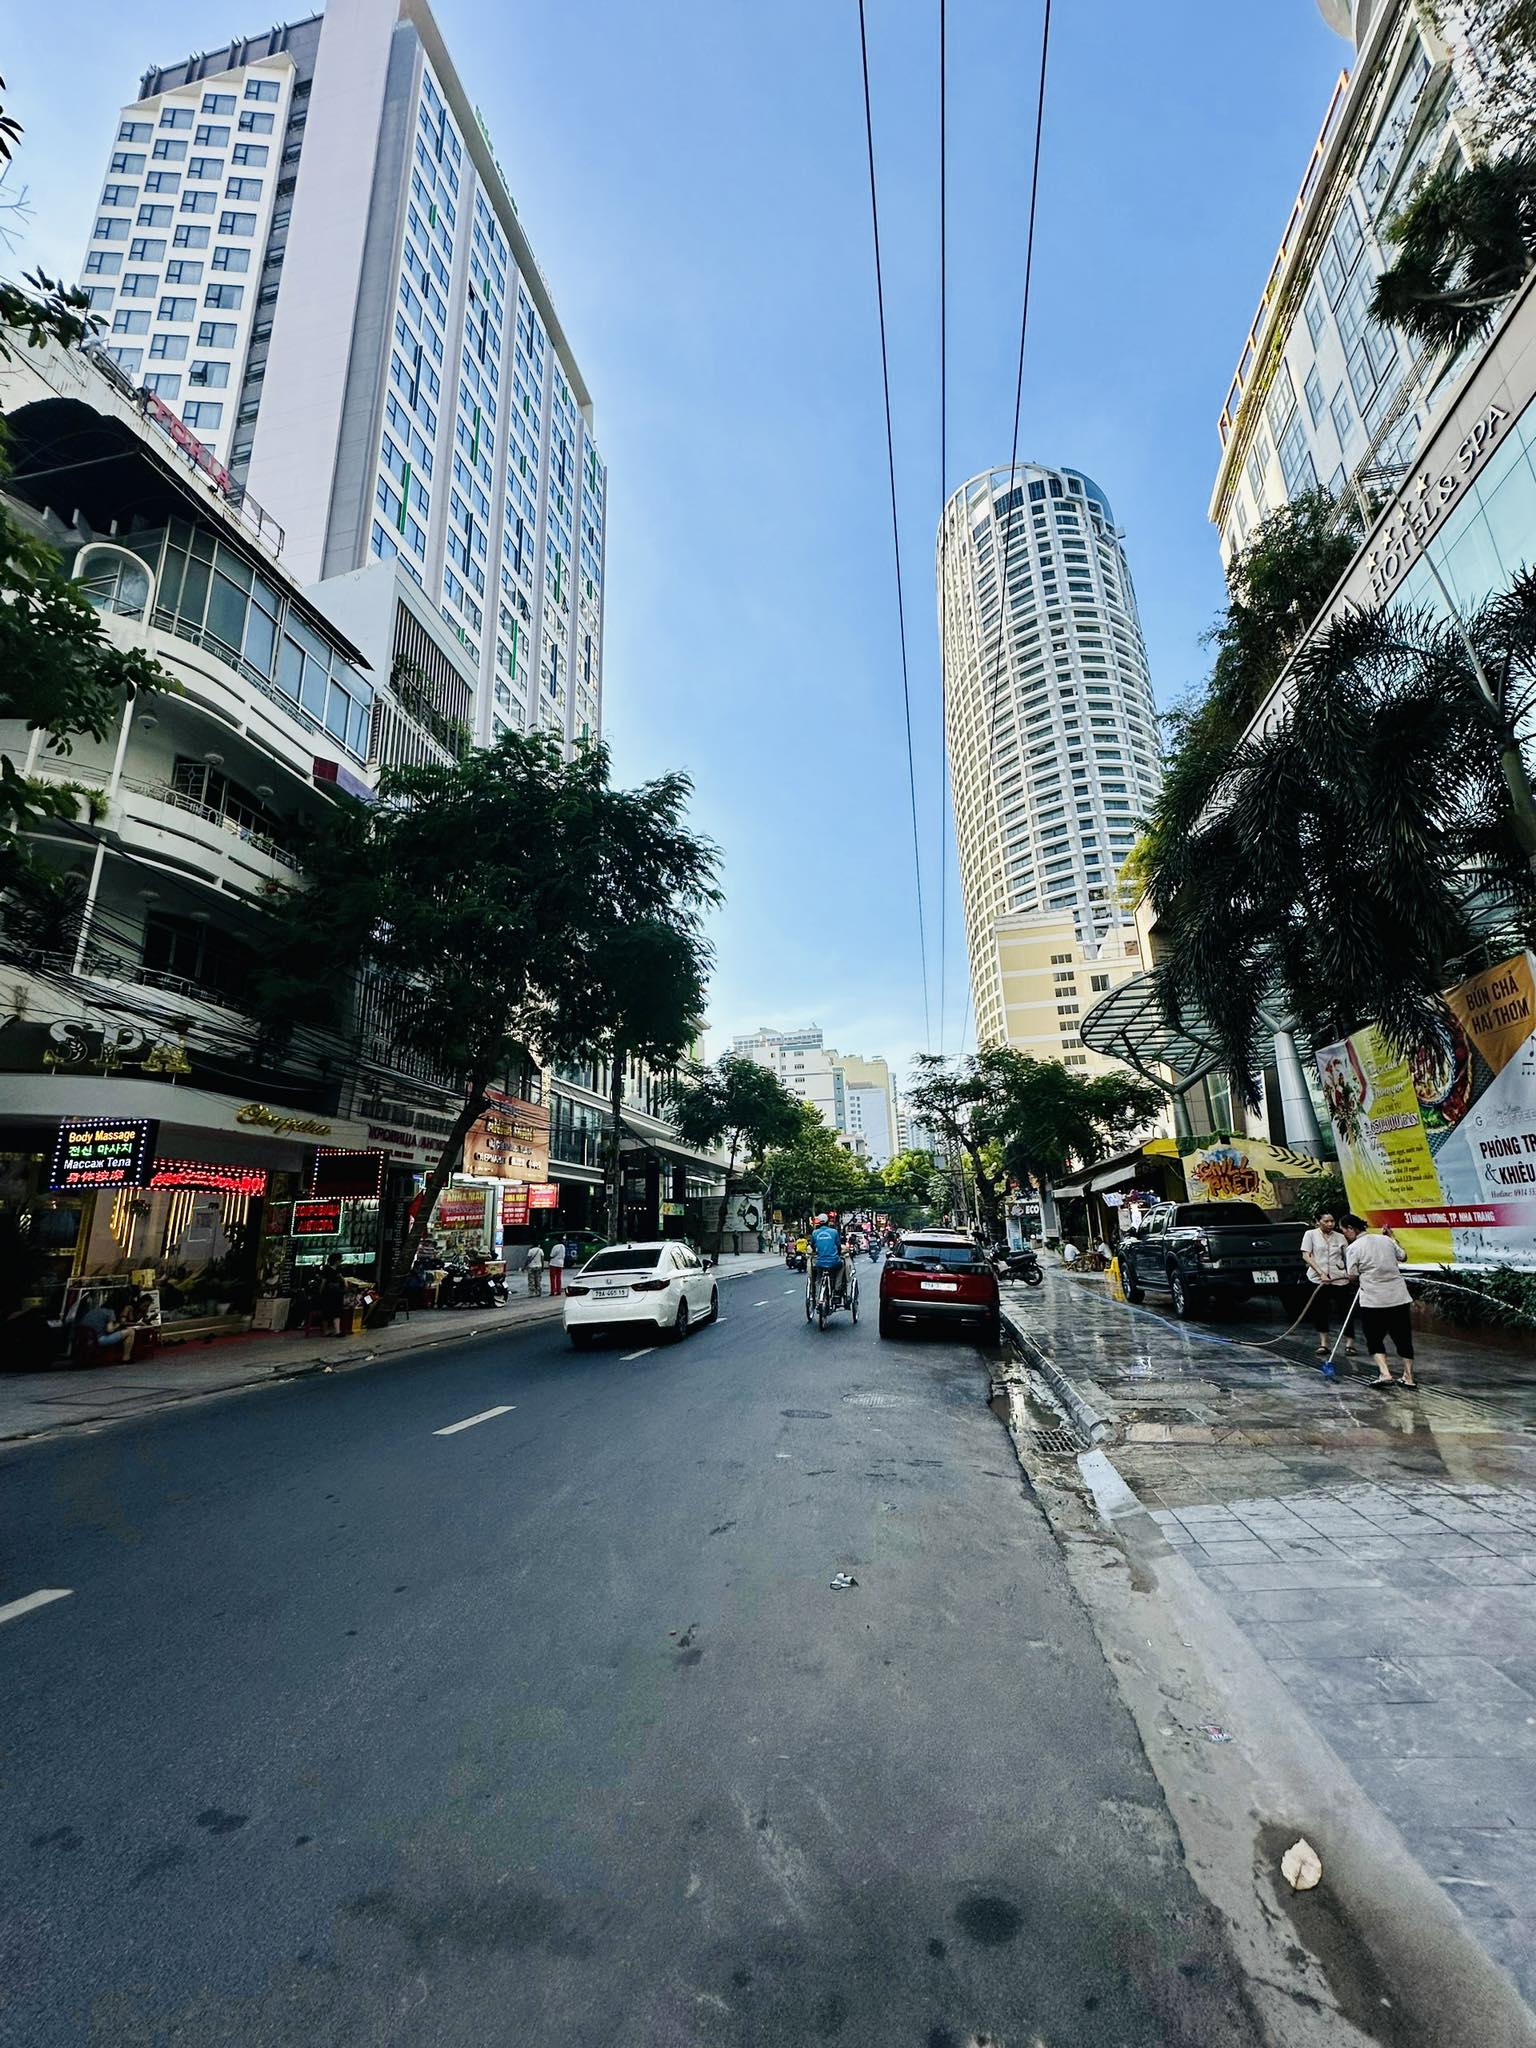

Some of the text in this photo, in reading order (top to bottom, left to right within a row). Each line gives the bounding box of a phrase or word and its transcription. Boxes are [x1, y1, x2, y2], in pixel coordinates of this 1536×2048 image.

[1370, 501, 1440, 602] HOTEL
[1437, 475, 1460, 504] &
[1457, 404, 1510, 474] SPA
[1466, 970, 1519, 1011] BÚN CHẢ
[68, 1130, 136, 1144] Body Massage
[68, 1143, 132, 1157] 전신 마사지
[1480, 1135, 1521, 1159] PHÒNG
[63, 1159, 104, 1169] Массаж
[1485, 1163, 1500, 1185] &
[1404, 1207, 1413, 1224] 31
[1449, 1212, 1459, 1222] TP.
[1459, 1211, 1473, 1222] NHA
[1473, 1210, 1496, 1222] TRANG
